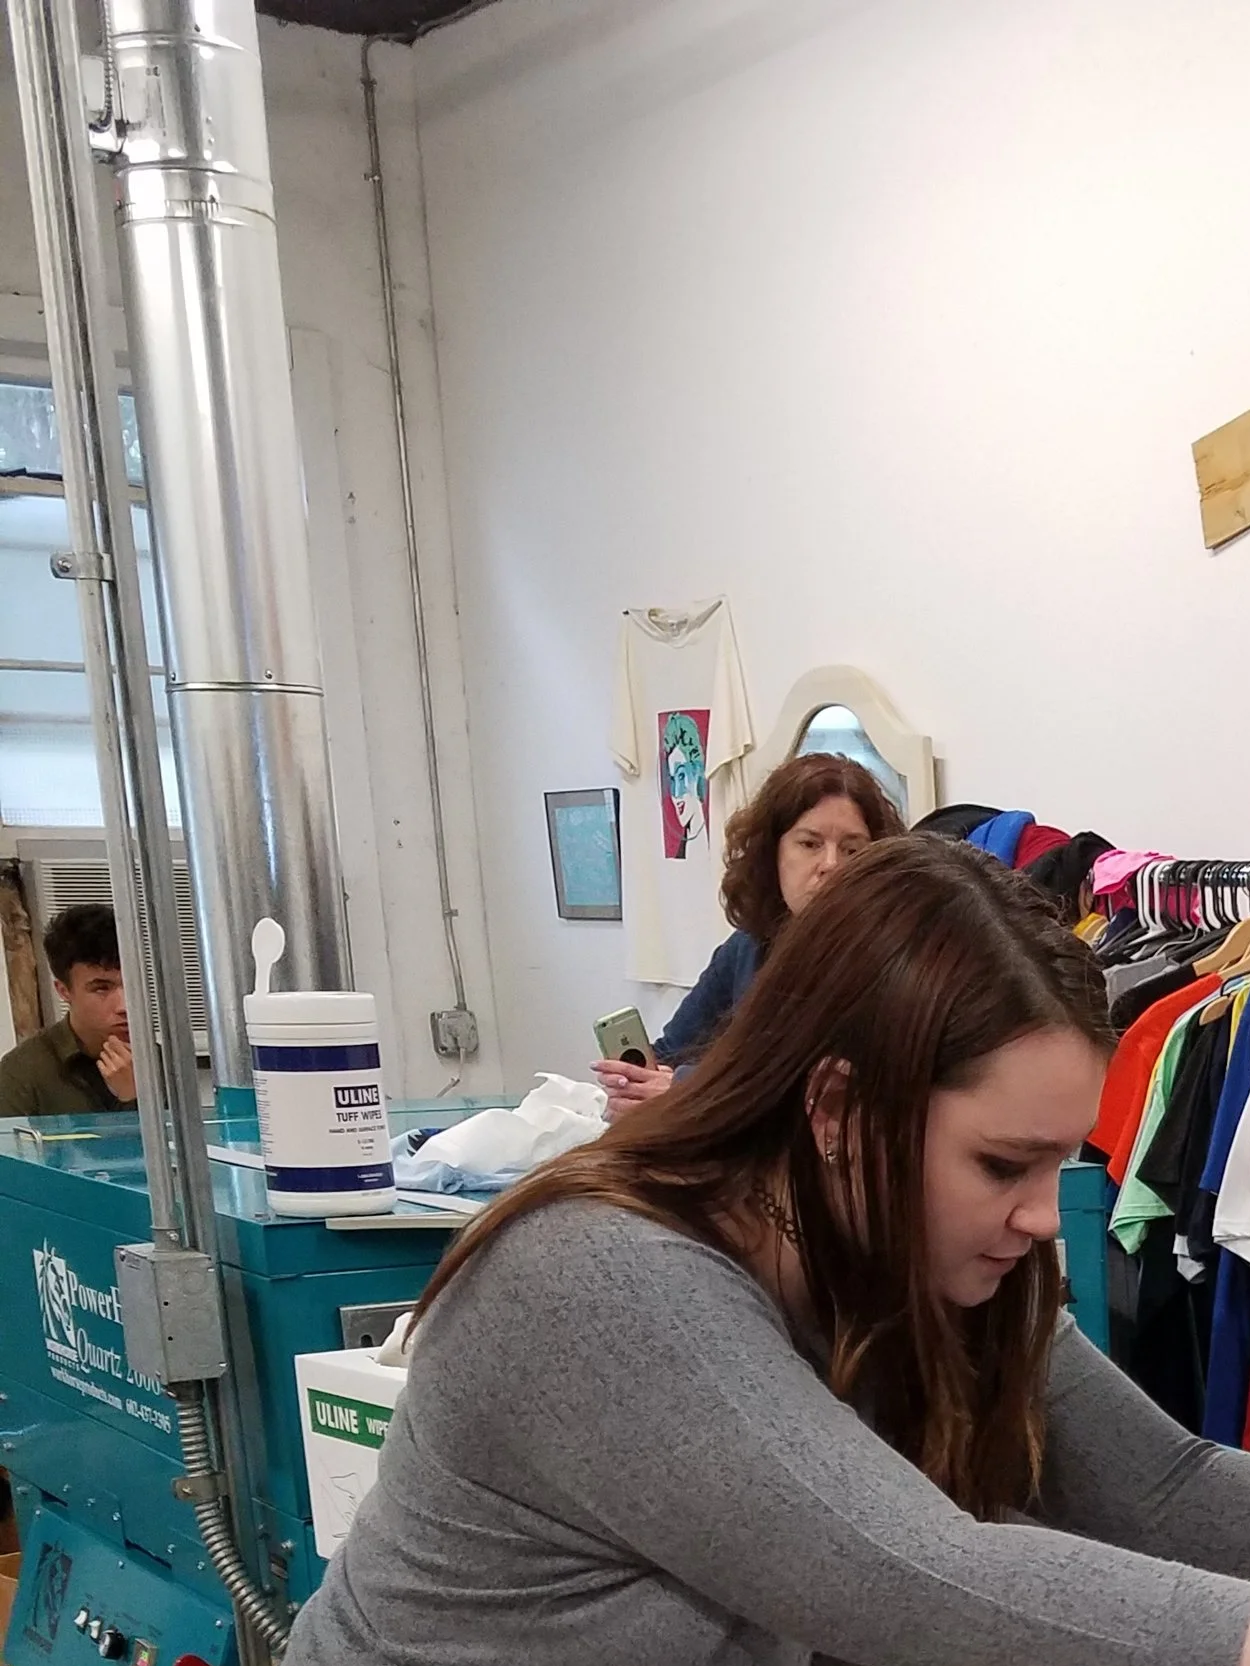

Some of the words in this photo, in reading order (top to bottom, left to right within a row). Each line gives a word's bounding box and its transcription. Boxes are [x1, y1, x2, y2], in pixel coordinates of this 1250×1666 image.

[337, 1088, 379, 1105] ULINE
[336, 1111, 359, 1122] TUFF
[361, 1109, 382, 1121] WIPES
[77, 1328, 122, 1378] Quartz
[315, 1400, 359, 1434] ULINE
